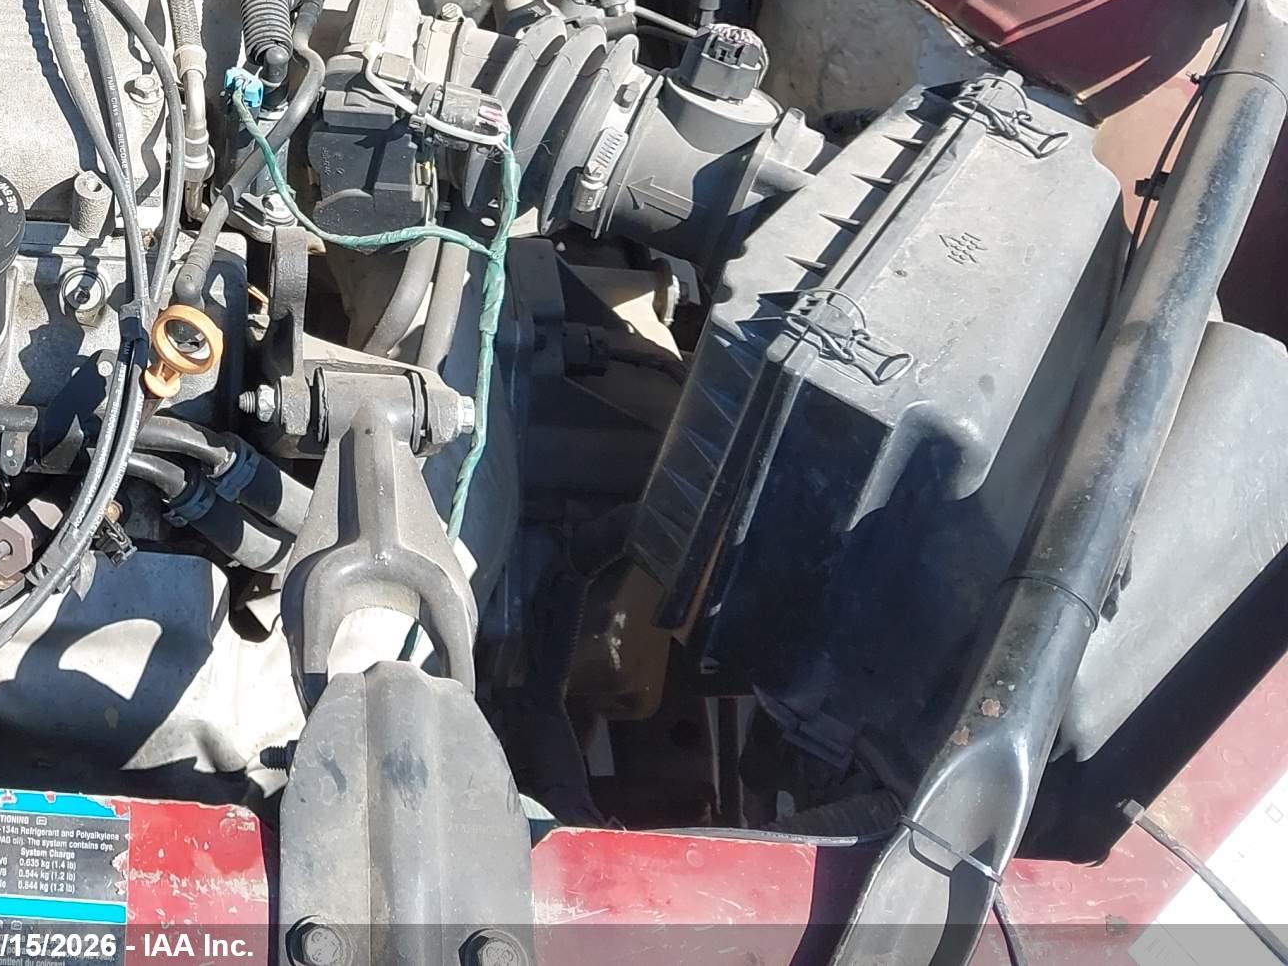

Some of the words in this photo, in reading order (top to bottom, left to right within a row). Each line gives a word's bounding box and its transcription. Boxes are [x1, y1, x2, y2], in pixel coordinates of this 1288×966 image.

[6, 195, 18, 214] SAE
[20, 826, 60, 838] Refrigerant
[61, 829, 75, 838] and
[75, 830, 120, 842] Polyalkylene
[27, 837, 41, 846] The
[41, 840, 68, 850] system
[68, 840, 99, 851] contains
[20, 847, 48, 857] System
[49, 849, 76, 860] Charge
[40, 860, 50, 870] kg
[51, 861, 65, 870] (1.4
[66, 861, 77, 871] lb)
[40, 870, 50, 881] kg
[50, 871, 65, 881] (1.2
[66, 872, 76, 882] lb)
[39, 882, 49, 892] kg
[50, 883, 65, 892] (1.2
[66, 883, 76, 894] lb)
